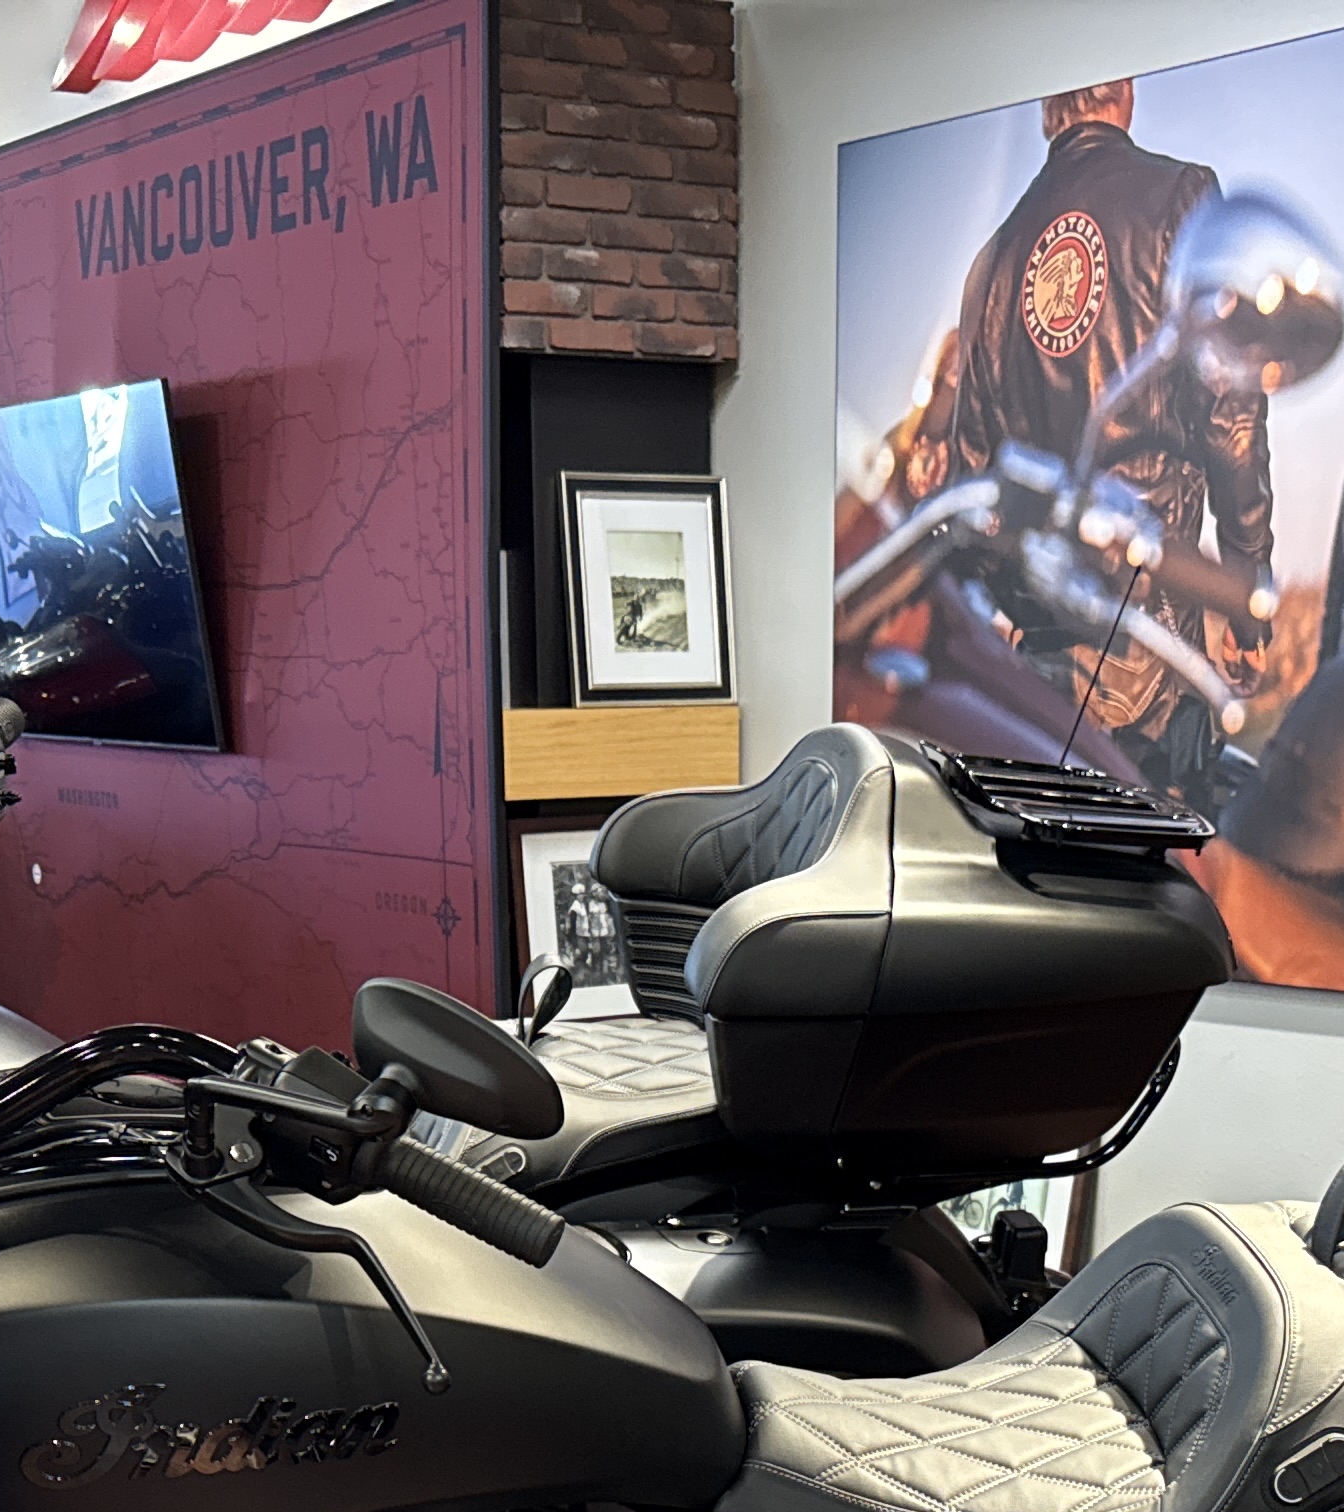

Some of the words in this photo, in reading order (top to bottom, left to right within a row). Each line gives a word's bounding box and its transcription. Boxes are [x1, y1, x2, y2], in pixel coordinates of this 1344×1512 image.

[75, 125, 346, 280] VANCOUVER,
[365, 95, 438, 208] WA
[1024, 250, 1043, 337] INDIAN
[1045, 216, 1105, 313] MOTORCYCLE
[1052, 328, 1081, 352] 1901
[375, 892, 427, 916] OREGON
[19, 1382, 400, 1490] Indian
